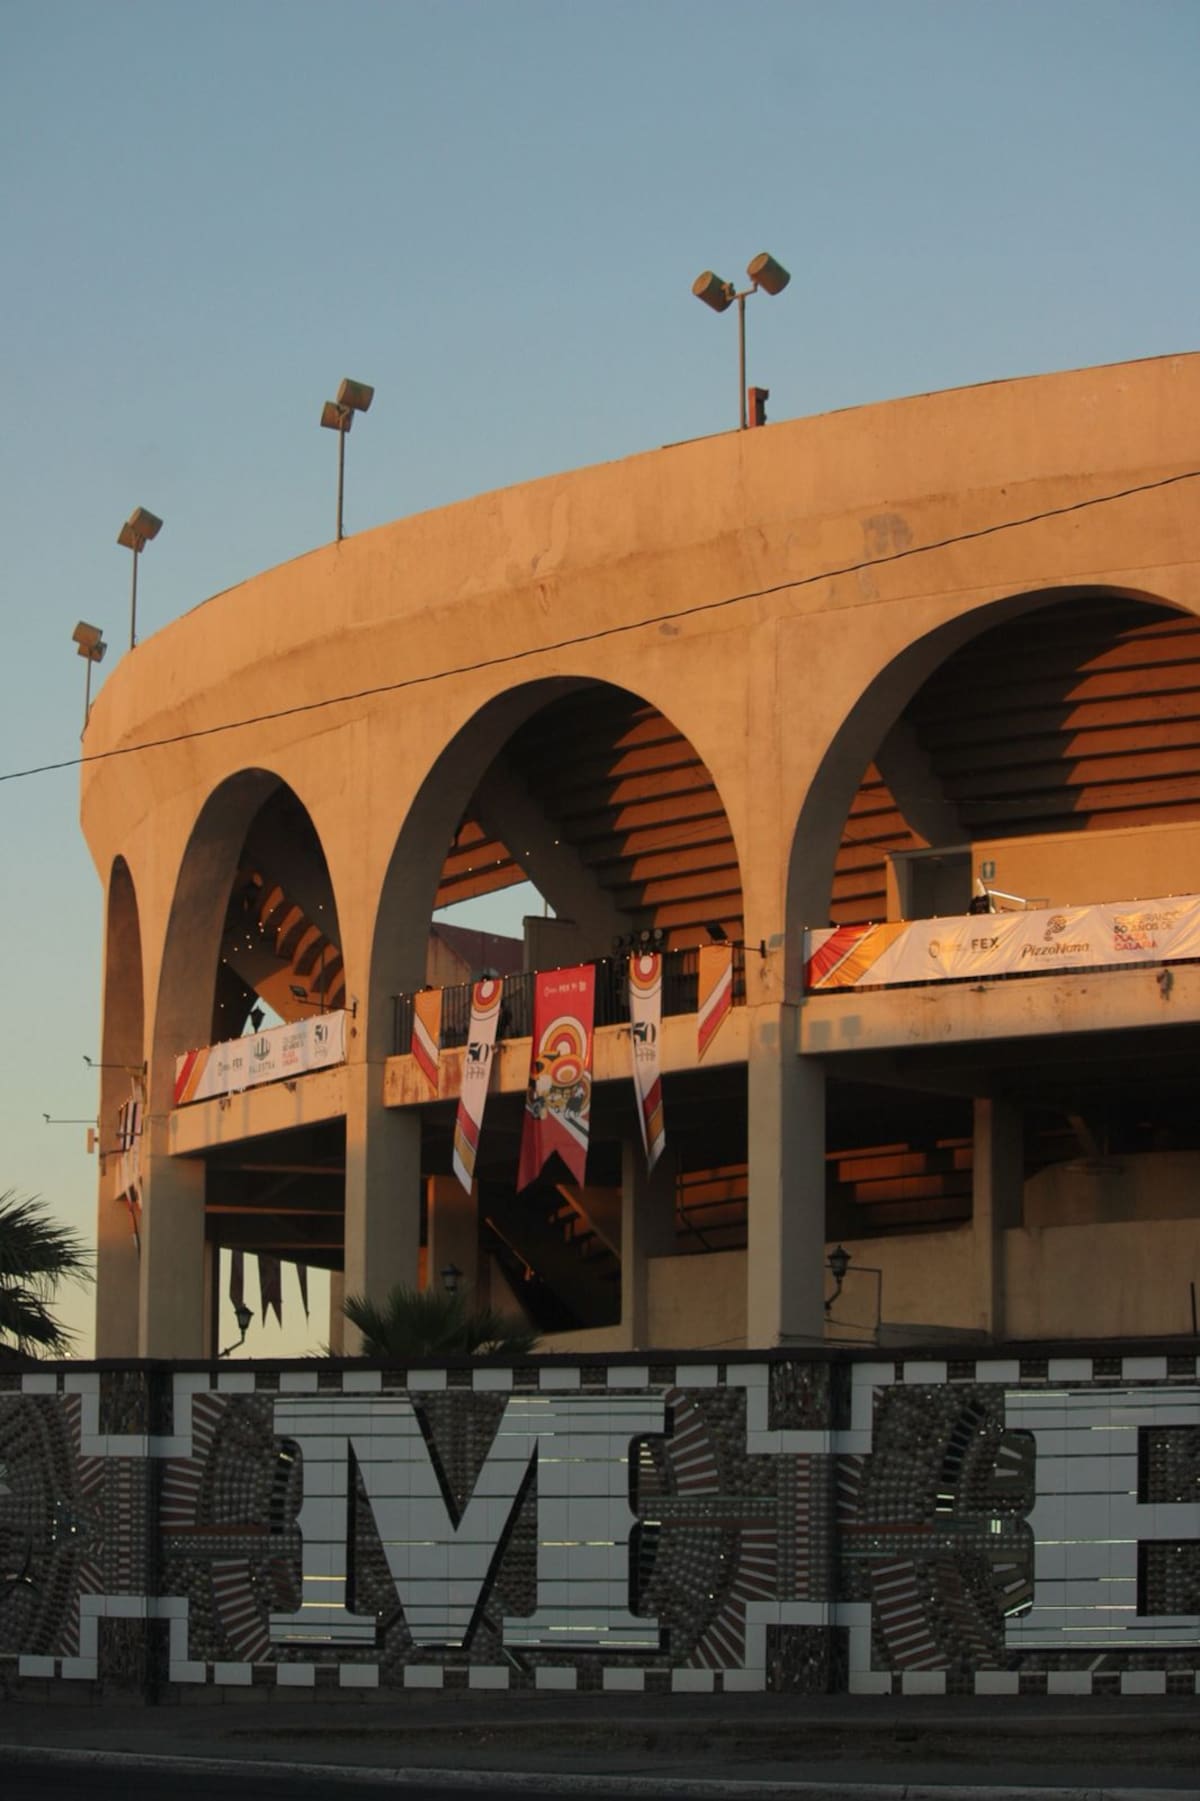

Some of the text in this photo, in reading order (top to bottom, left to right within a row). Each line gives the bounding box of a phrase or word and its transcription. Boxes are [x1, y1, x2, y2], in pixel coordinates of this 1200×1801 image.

[971, 936, 999, 950] FEX
[313, 1023, 328, 1042] 50
[632, 1022, 656, 1043] 50
[467, 1042, 489, 1062] 50
